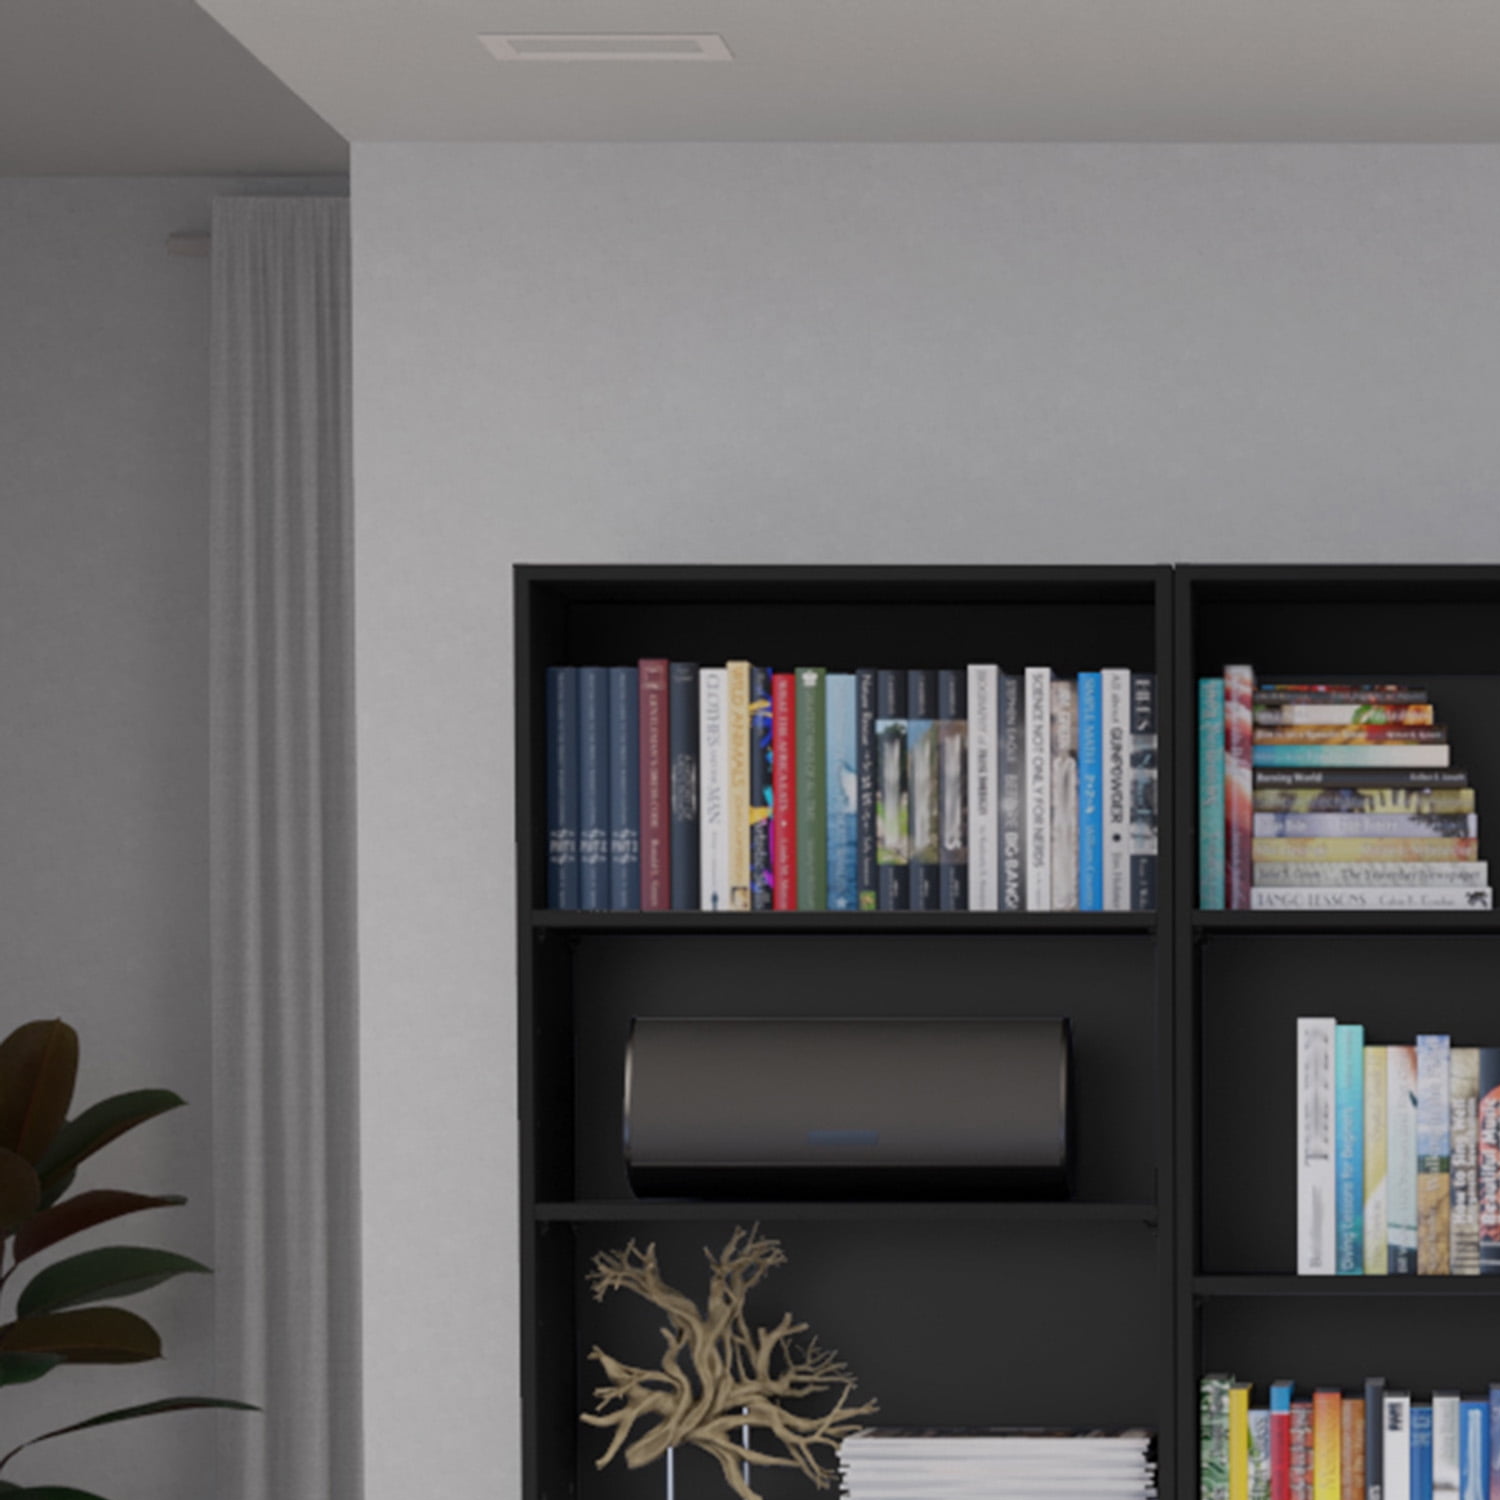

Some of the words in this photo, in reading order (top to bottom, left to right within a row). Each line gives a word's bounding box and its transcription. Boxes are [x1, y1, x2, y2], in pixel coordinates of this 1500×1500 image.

[707, 673, 721, 746] CLOTHES
[1032, 673, 1044, 722] SCIENCE
[1032, 724, 1044, 754] NOT
[1032, 757, 1044, 796] ONLY
[1110, 727, 1122, 824] GUNPOWDER
[1294, 772, 1323, 784] World
[708, 786, 722, 825] MAN
[1032, 798, 1044, 825] FOR
[1004, 832, 1018, 857] BIG
[1032, 827, 1044, 868] NERDS
[1257, 895, 1304, 908] TANGO
[1307, 895, 1367, 908] LESSONS
[1341, 1160, 1356, 1178] for
[1452, 1170, 1466, 1187] to
[1481, 1150, 1496, 1225] Beautiful
[1341, 1182, 1356, 1227] Lessons
[1341, 1231, 1356, 1271] Diving
